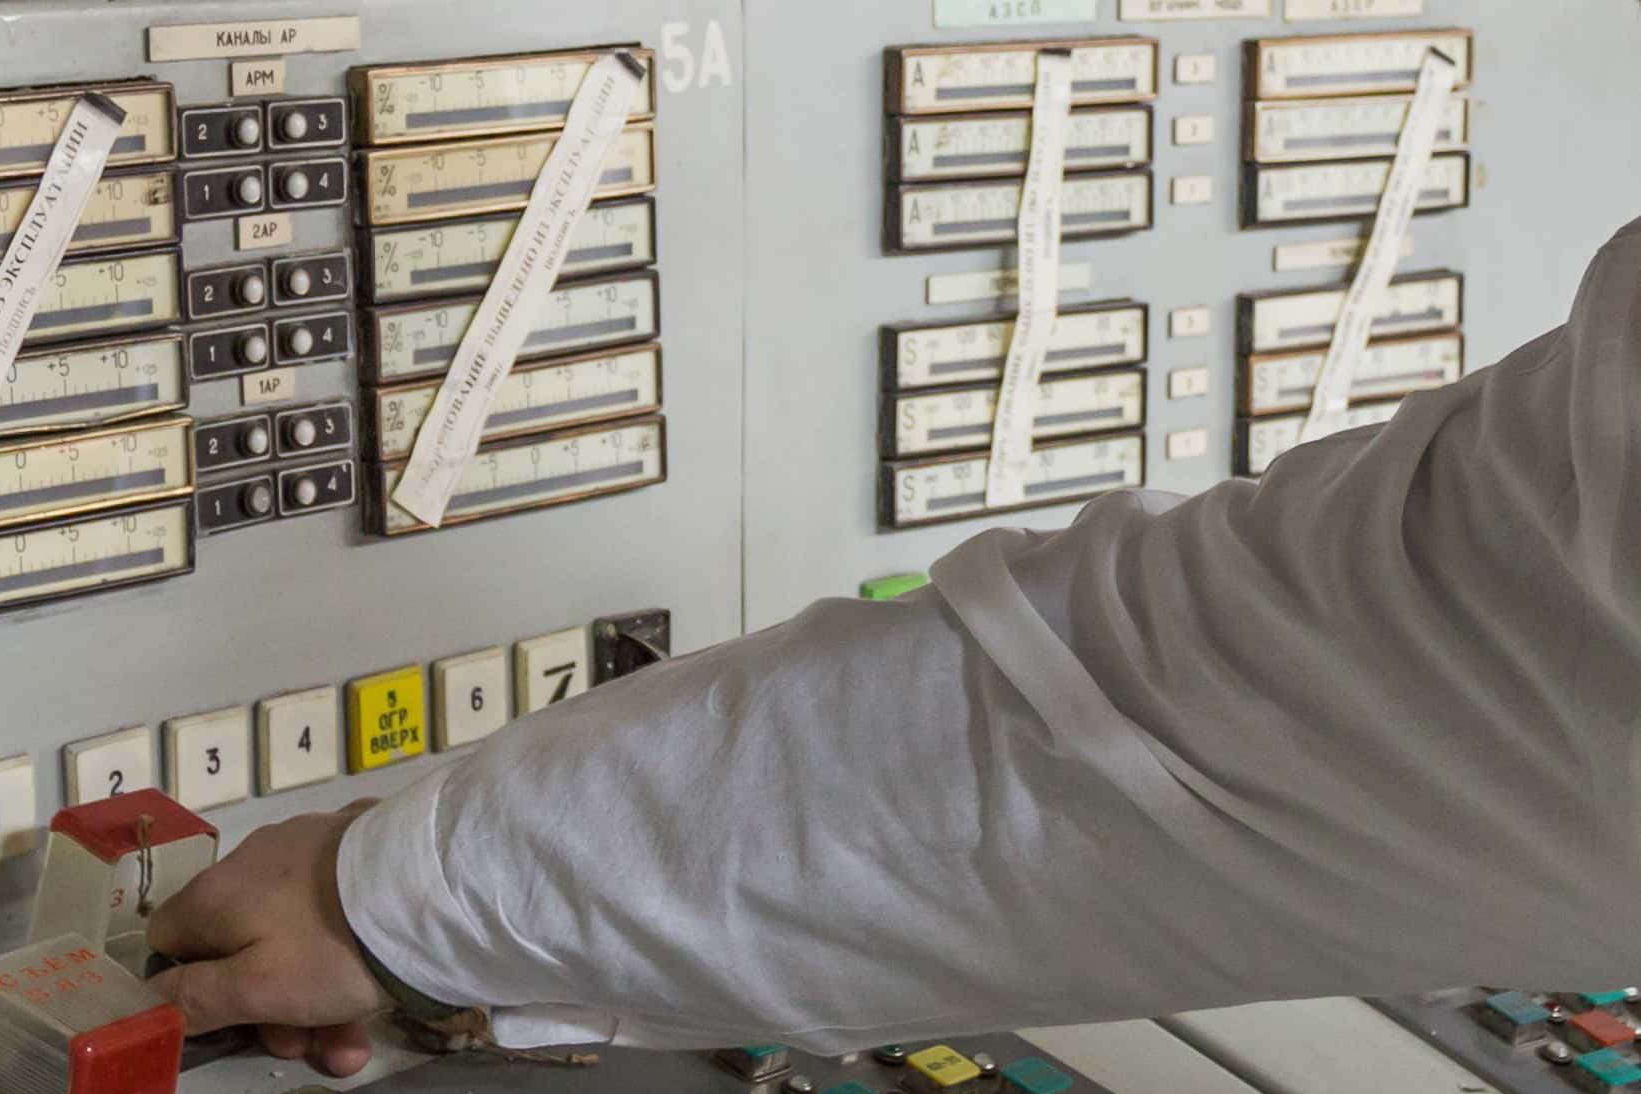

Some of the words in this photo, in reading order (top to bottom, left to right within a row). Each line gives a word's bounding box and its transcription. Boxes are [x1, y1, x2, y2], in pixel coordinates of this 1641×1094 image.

[217, 30, 271, 47] КАНАЛЫ
[280, 29, 296, 43] АР
[245, 69, 274, 86] АРМ
[318, 114, 327, 130] 3
[319, 173, 328, 189] 4
[253, 222, 277, 239] 2АР
[322, 269, 332, 284] 3
[322, 327, 332, 343] 4
[210, 346, 215, 362] 1
[259, 379, 280, 394] 1АР
[325, 418, 334, 434] 3
[209, 439, 218, 454] 2
[328, 476, 337, 491] 4
[215, 500, 221, 516] 1
[386, 690, 397, 708] 5
[469, 685, 484, 714] 6
[378, 707, 409, 732] ОГР
[297, 724, 313, 754] 4
[368, 723, 421, 756] ВВЕРХ
[206, 747, 221, 776] 3
[108, 769, 123, 798] 2
